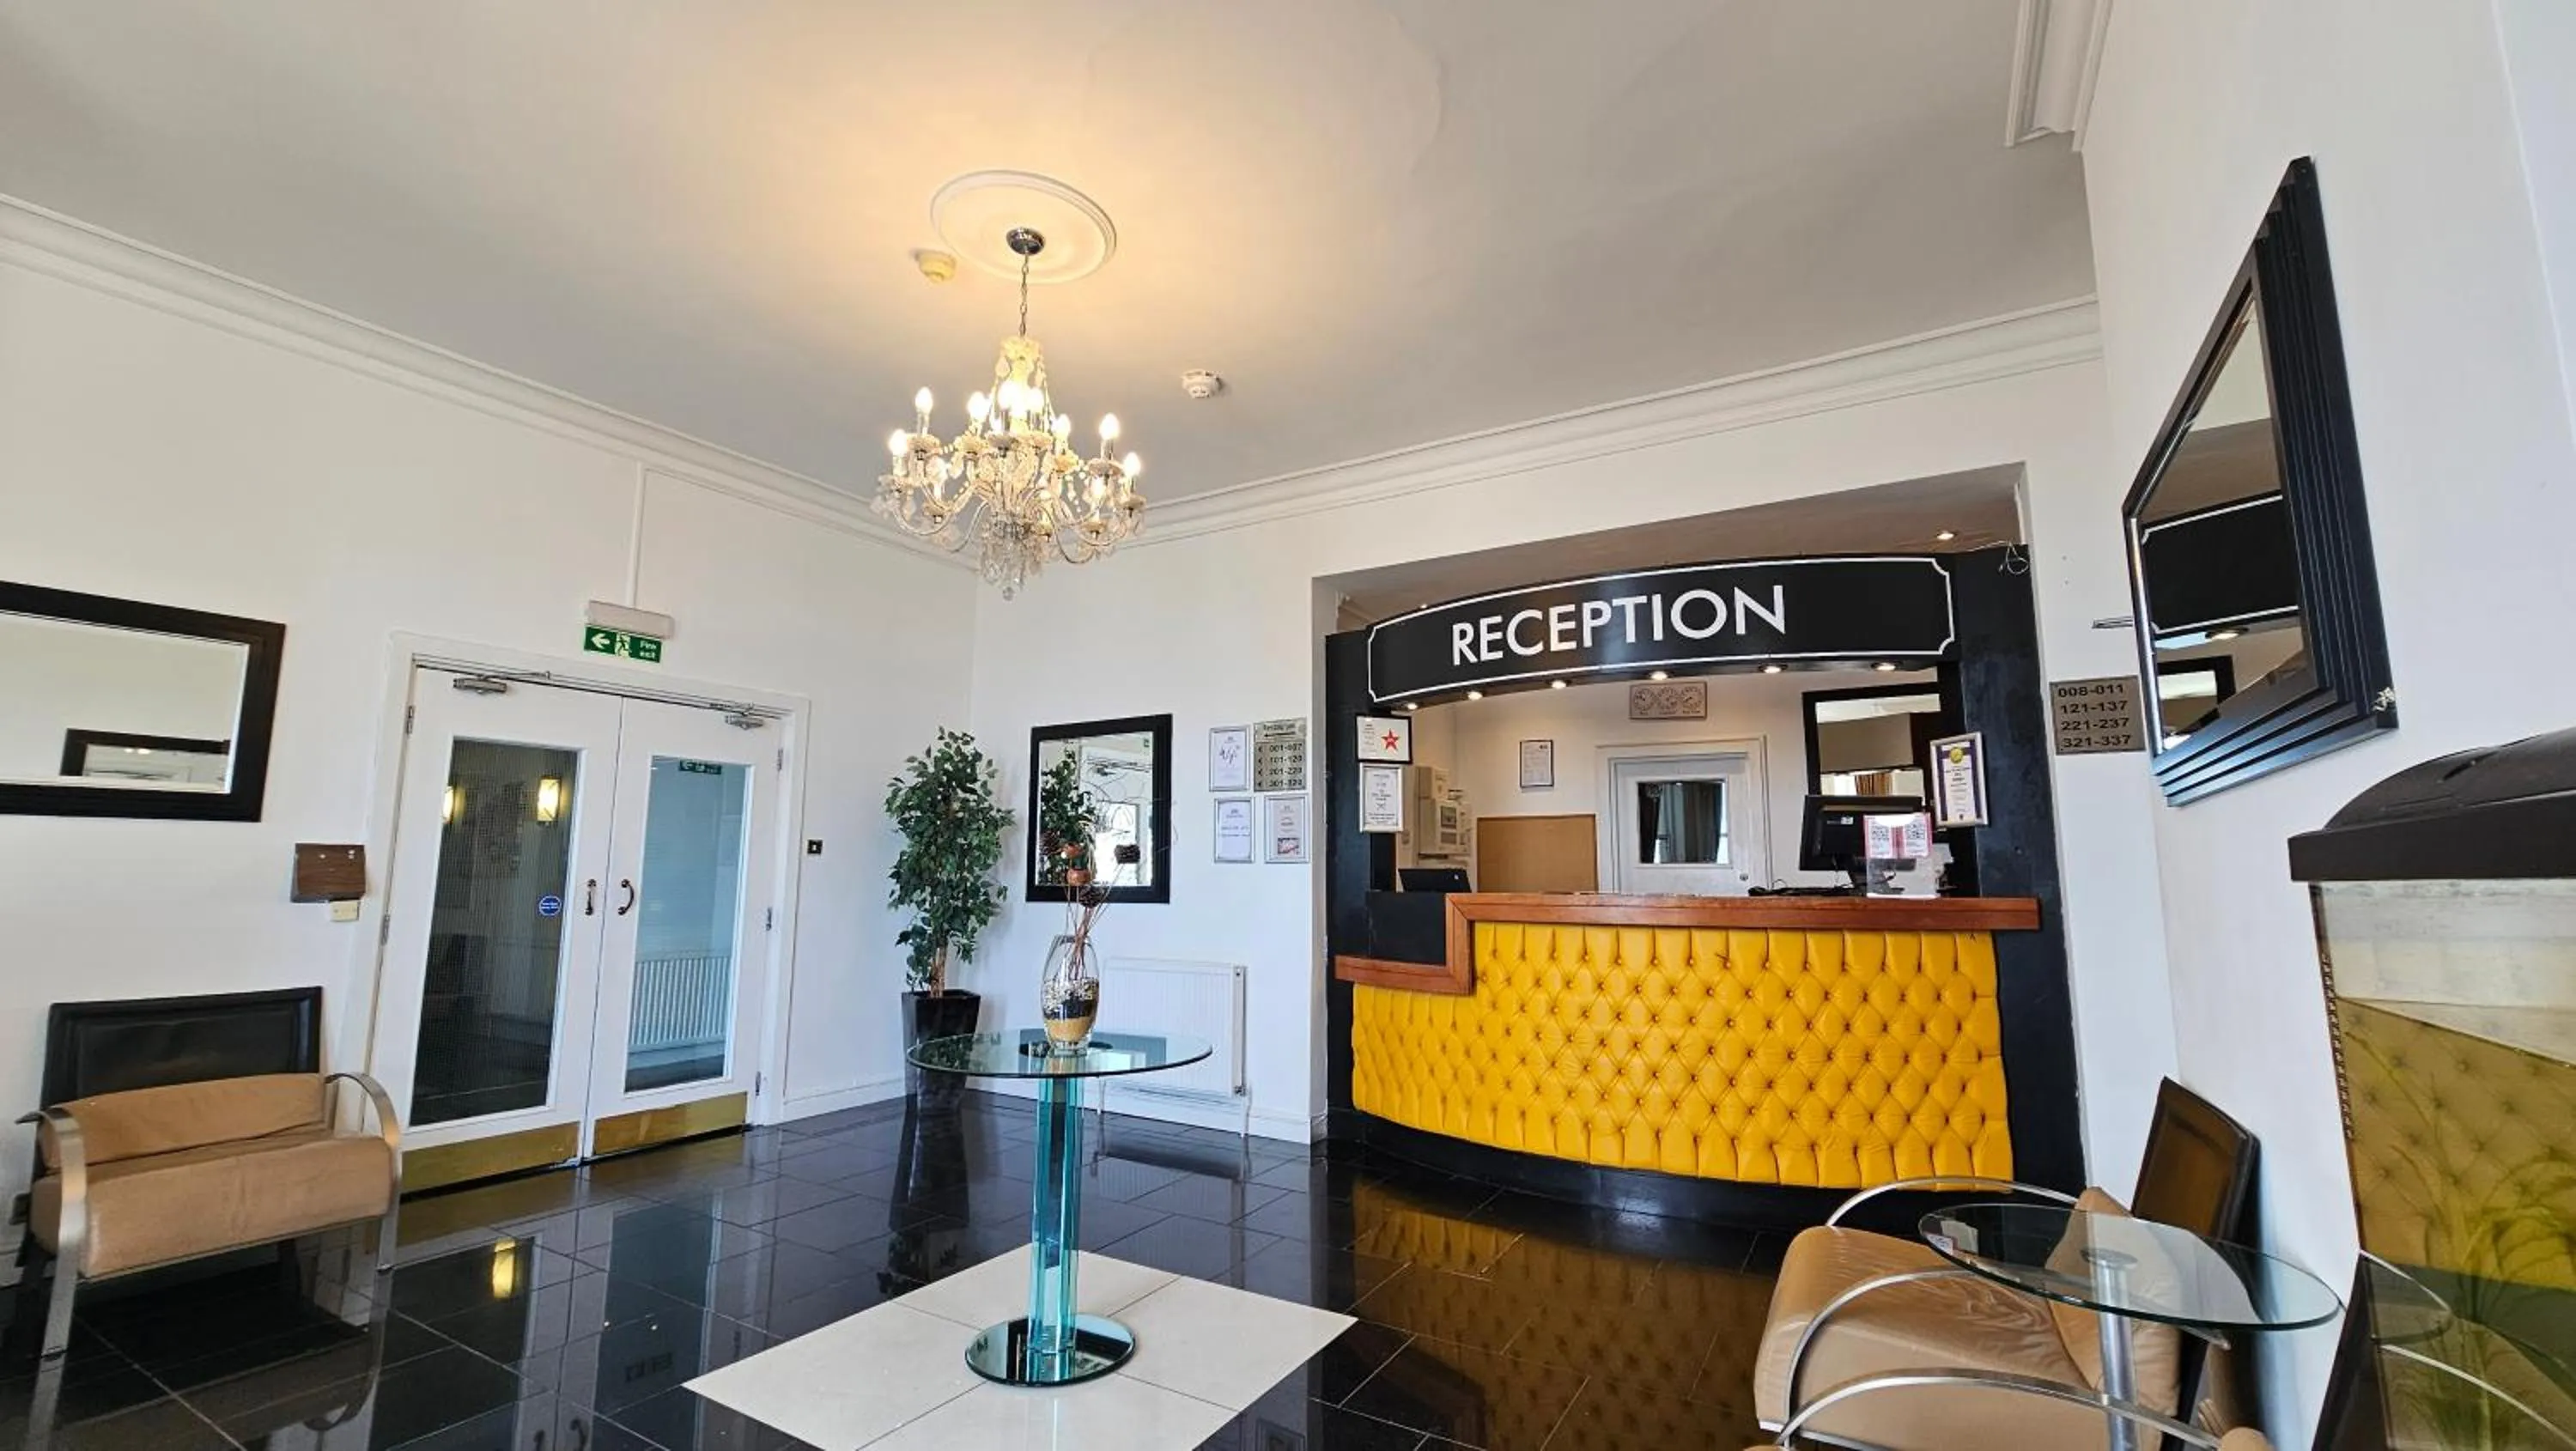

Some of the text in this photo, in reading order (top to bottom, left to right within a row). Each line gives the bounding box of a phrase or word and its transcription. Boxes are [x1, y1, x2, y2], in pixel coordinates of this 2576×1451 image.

[1452, 585, 1786, 666] RECEPTION
[2058, 684, 2123, 697] 008-011
[2061, 700, 2128, 713] 121-137
[2061, 717, 2129, 730] 221-237
[2063, 734, 2130, 747] 321-337
